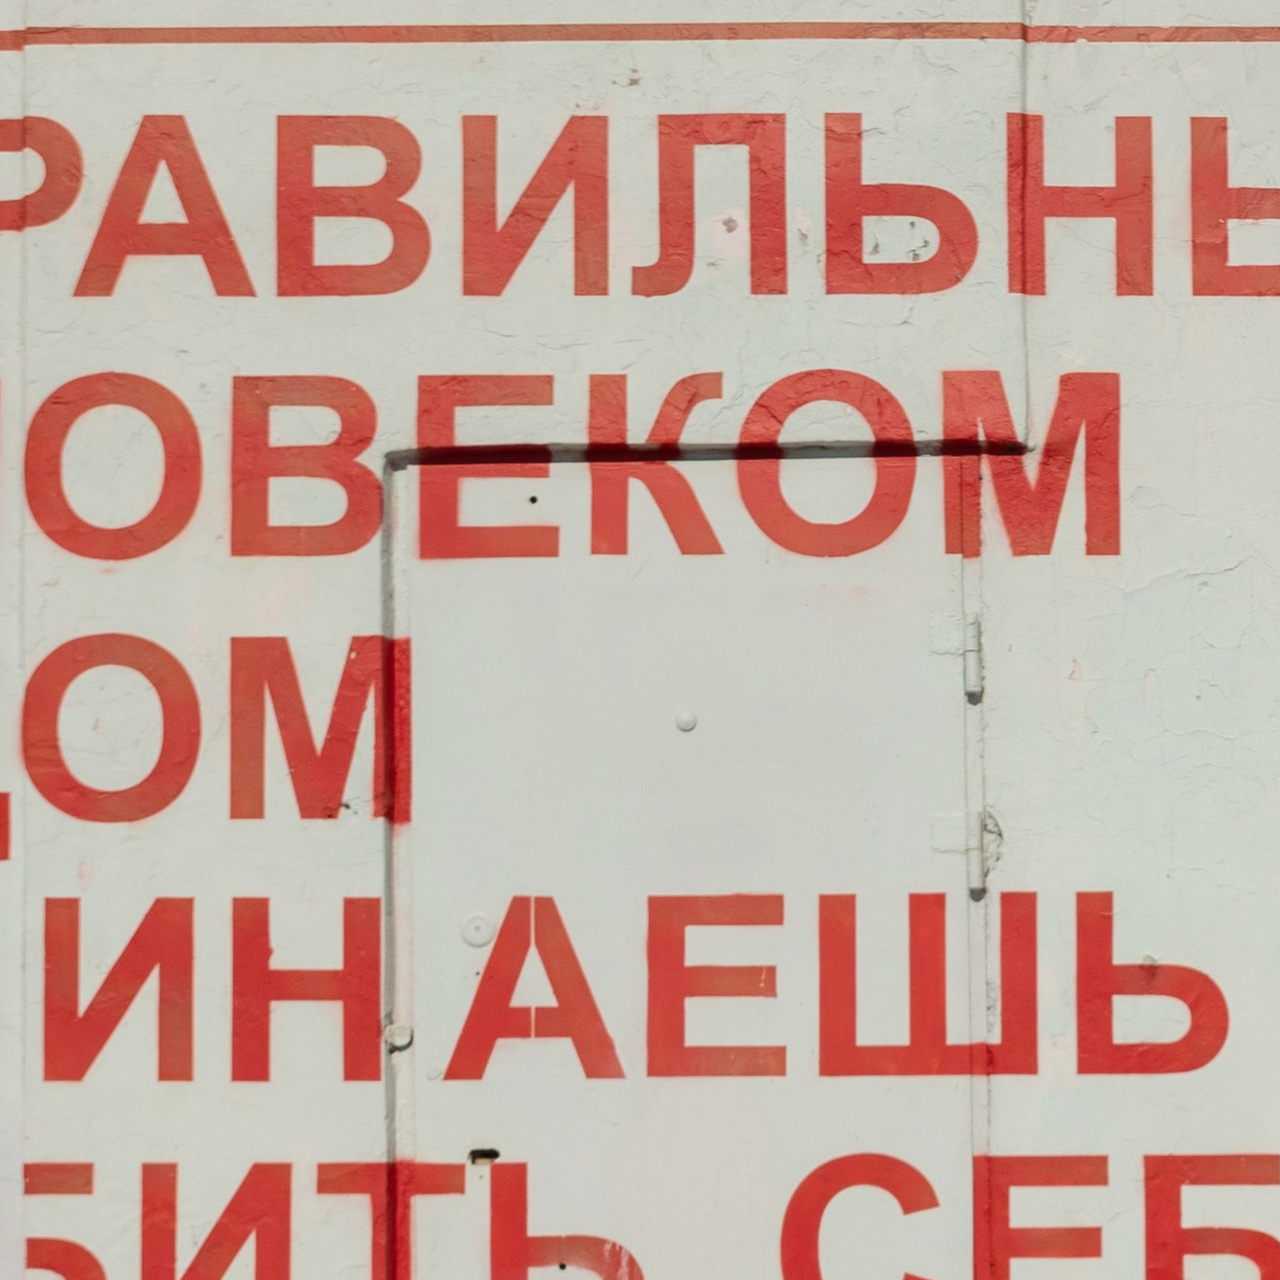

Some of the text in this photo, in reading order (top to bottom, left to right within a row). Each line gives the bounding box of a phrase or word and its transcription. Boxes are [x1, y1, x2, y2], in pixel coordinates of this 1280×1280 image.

[0, 369, 1121, 560] ОВЕКОМ
[0, 633, 413, 860] ОМ
[43, 891, 1230, 1083] ИНАЕШЬ
